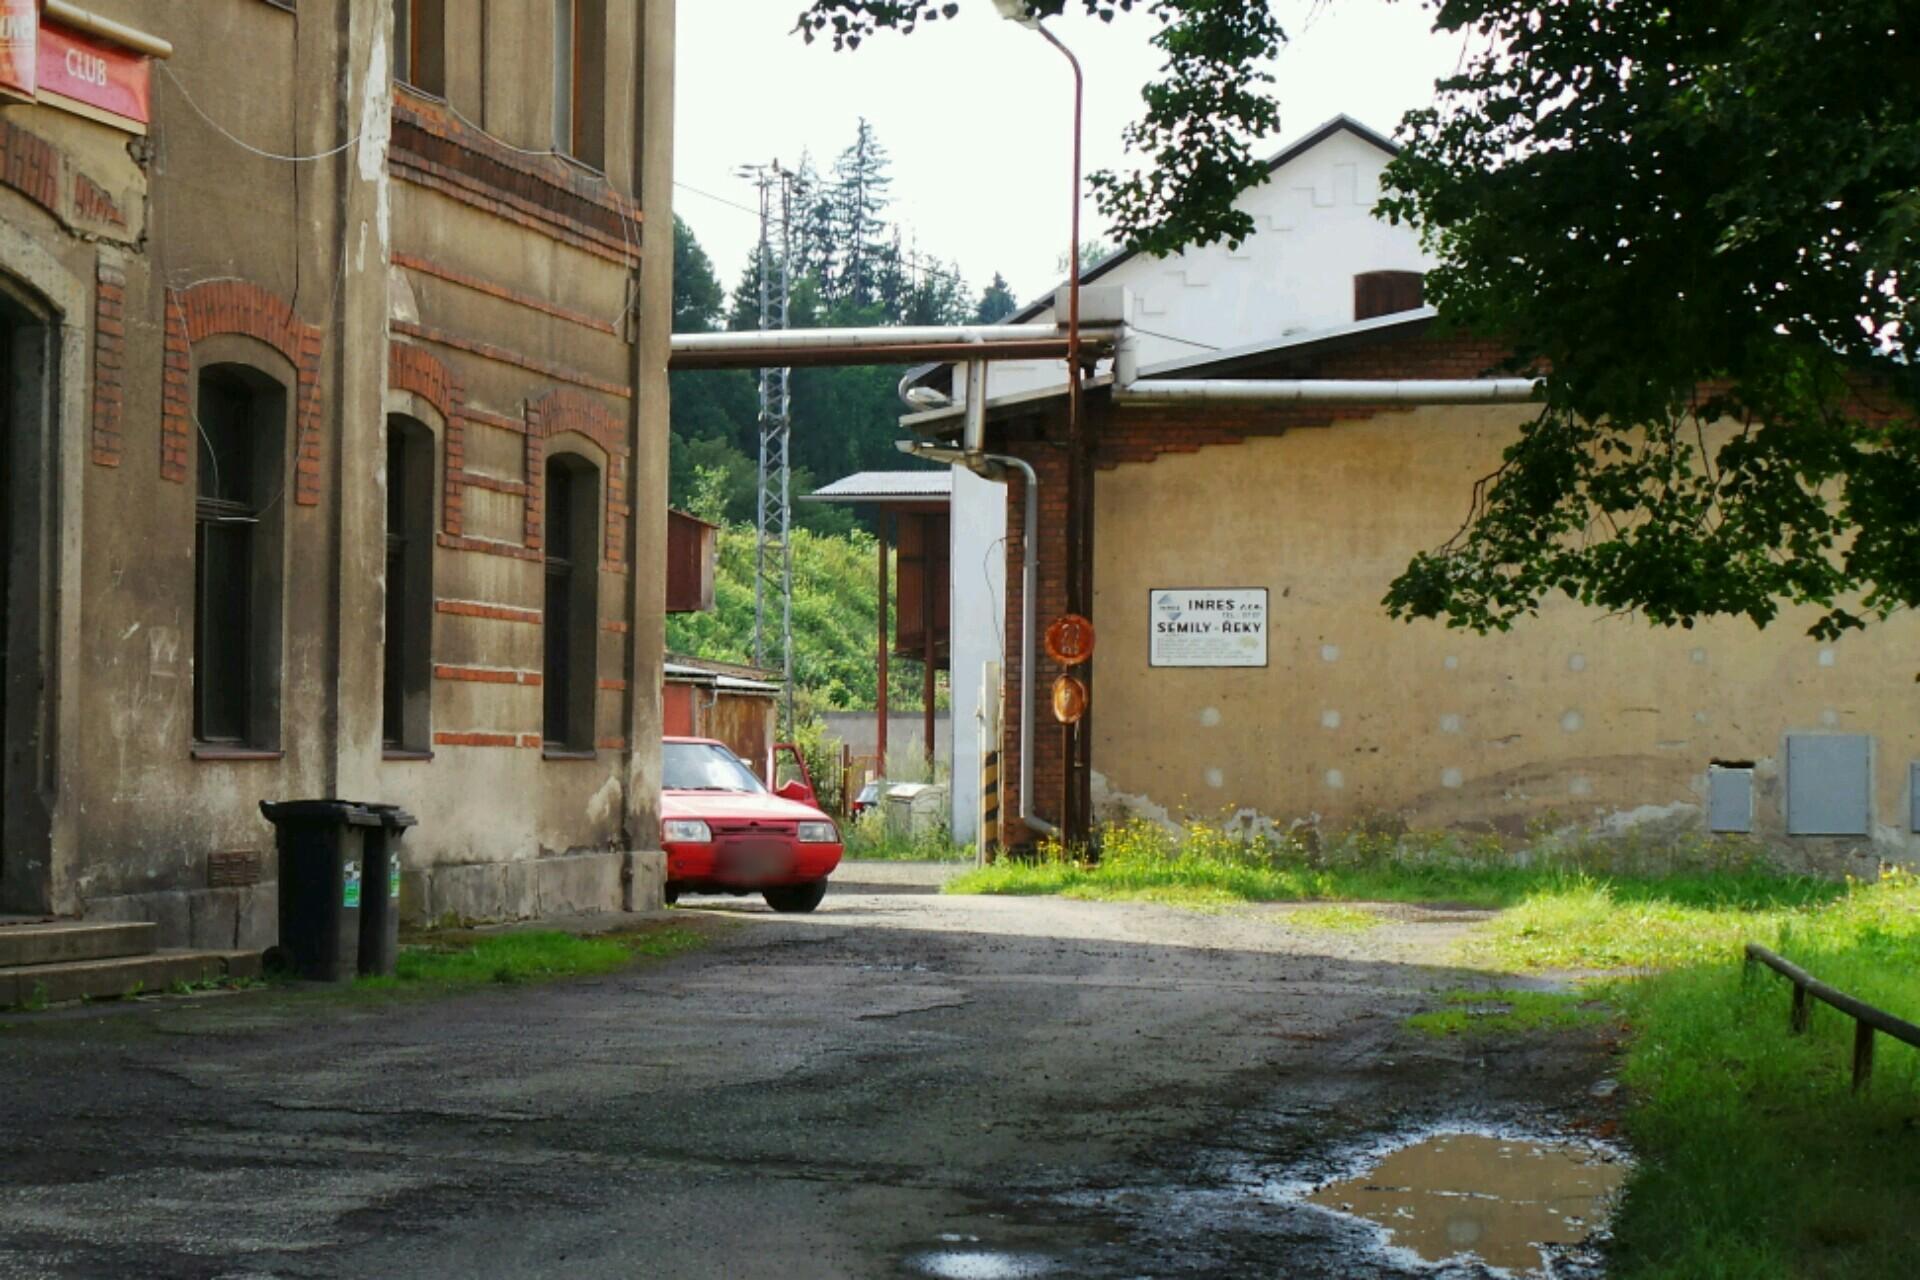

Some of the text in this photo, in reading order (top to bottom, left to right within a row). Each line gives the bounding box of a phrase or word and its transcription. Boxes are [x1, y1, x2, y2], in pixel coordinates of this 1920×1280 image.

[65, 48, 107, 86] CLUB
[1188, 599, 1235, 611] INRES
[1157, 621, 1212, 633] SEMILY
[1222, 620, 1262, 633] ŘEKY
